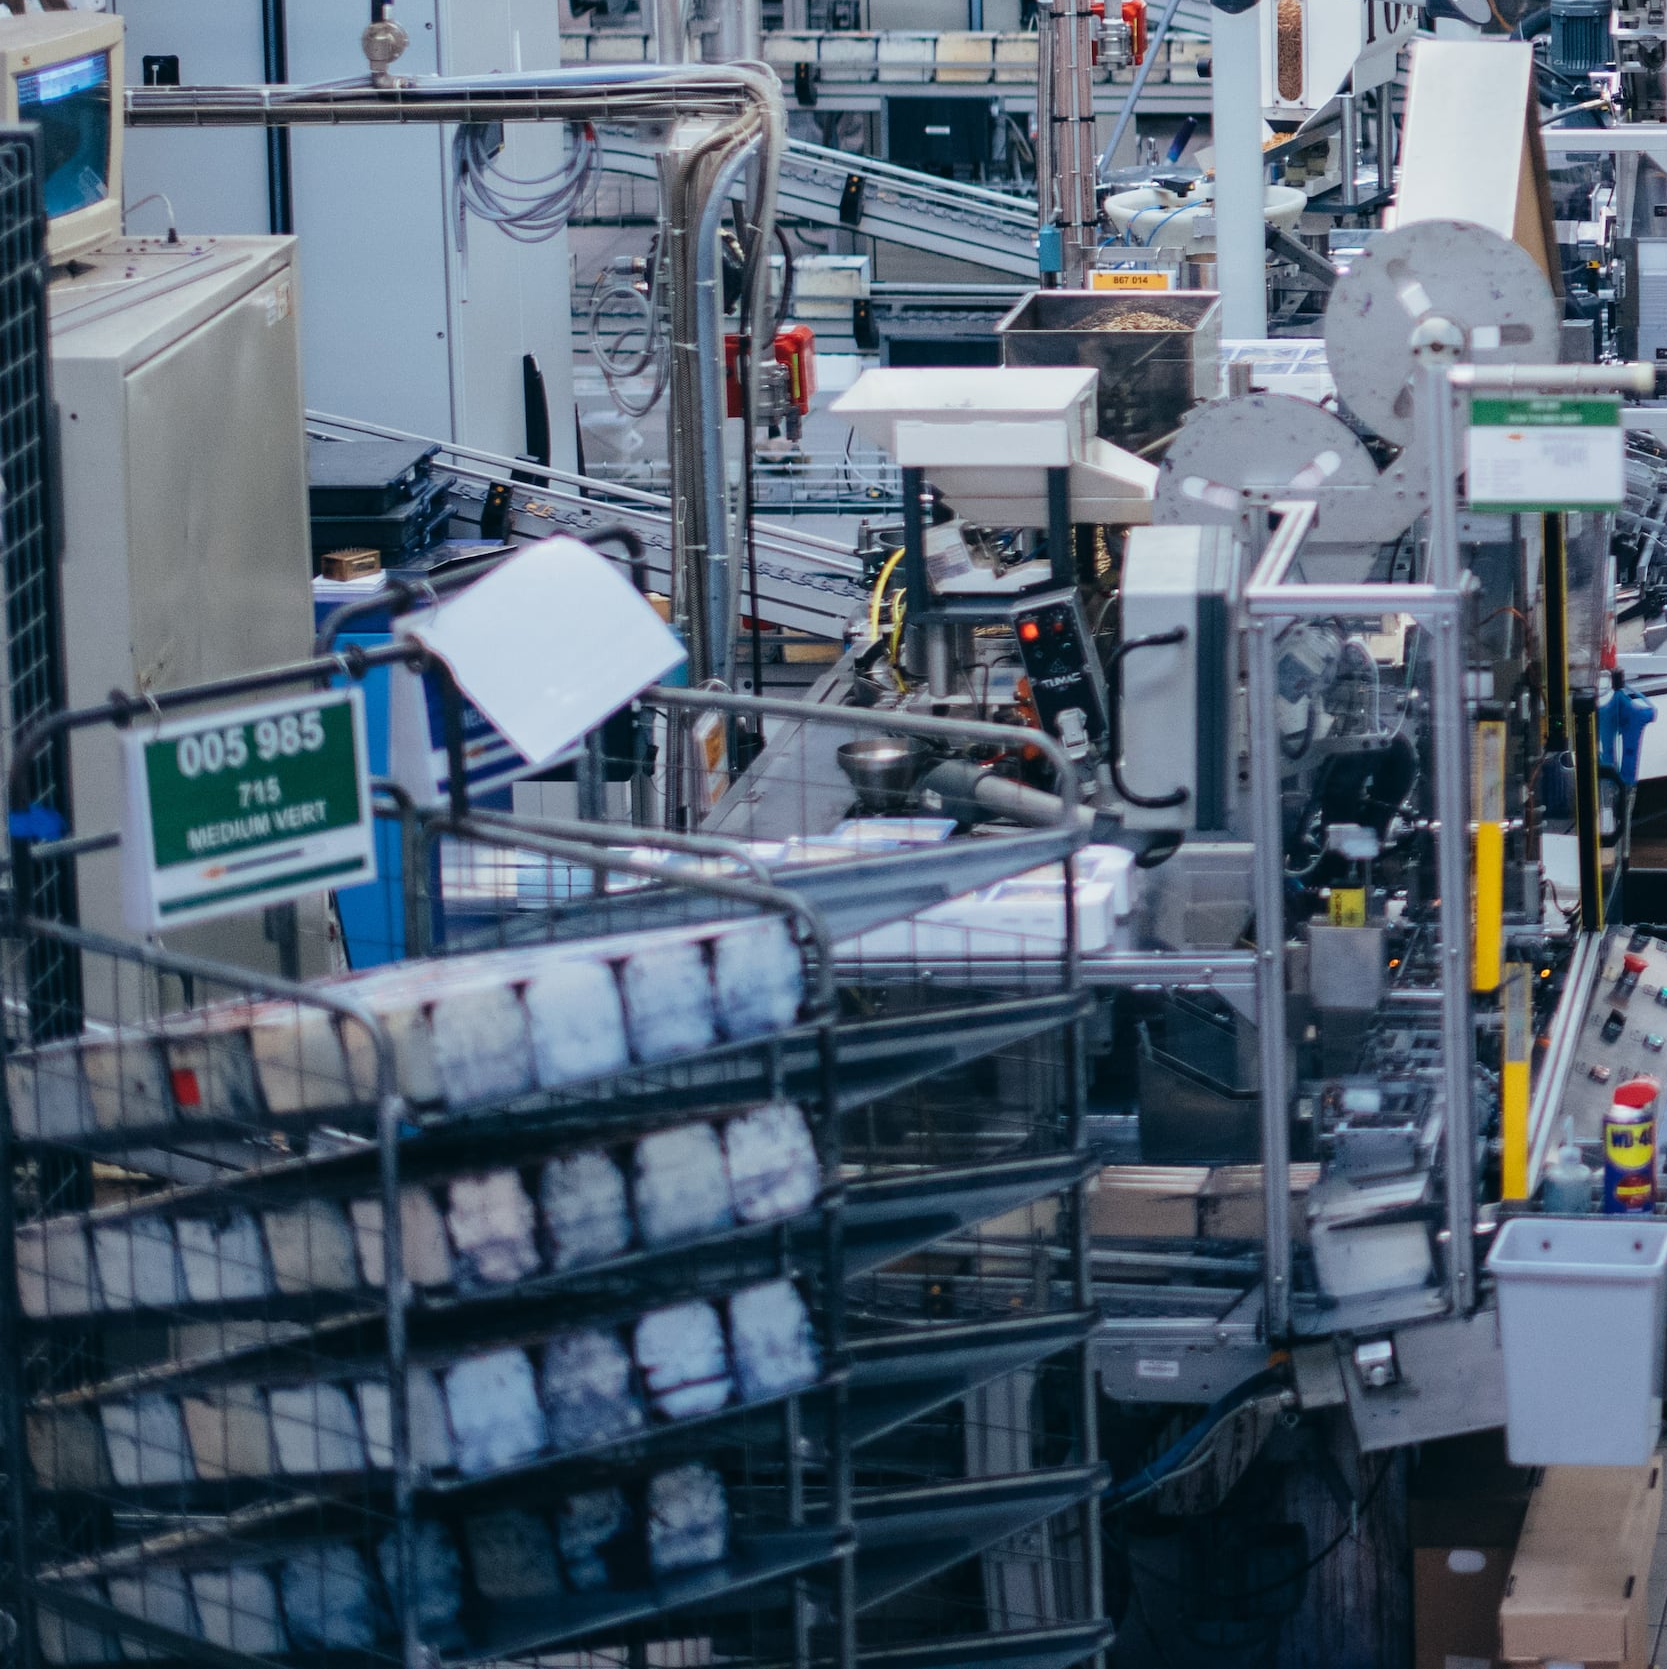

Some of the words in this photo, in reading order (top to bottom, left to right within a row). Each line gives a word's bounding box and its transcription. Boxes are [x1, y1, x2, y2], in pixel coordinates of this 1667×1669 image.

[1132, 276, 1148, 284] 014
[177, 725, 249, 779] 005
[253, 708, 325, 762] 985
[236, 774, 282, 810] 715
[185, 811, 272, 852] MEDIUM
[272, 799, 327, 831] VERT
